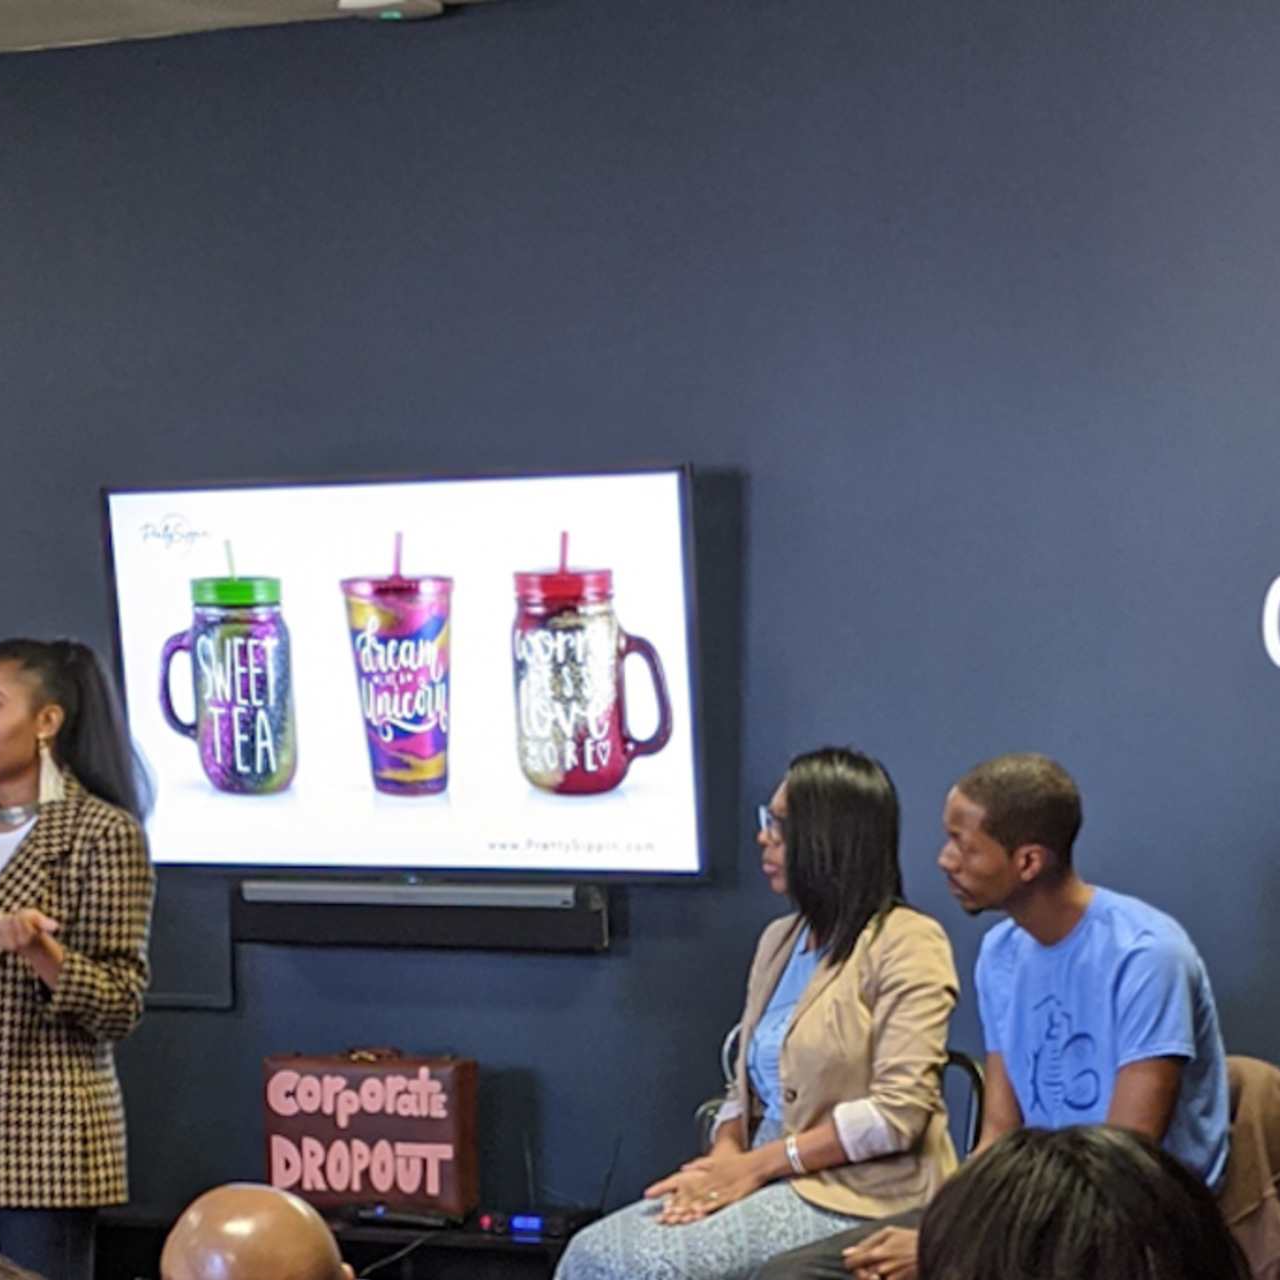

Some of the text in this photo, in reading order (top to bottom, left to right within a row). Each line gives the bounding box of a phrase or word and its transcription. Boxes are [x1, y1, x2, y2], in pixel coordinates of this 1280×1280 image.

[196, 634, 279, 706] SWEET
[207, 706, 277, 774] TEA
[271, 1134, 454, 1196] DROPOUT
